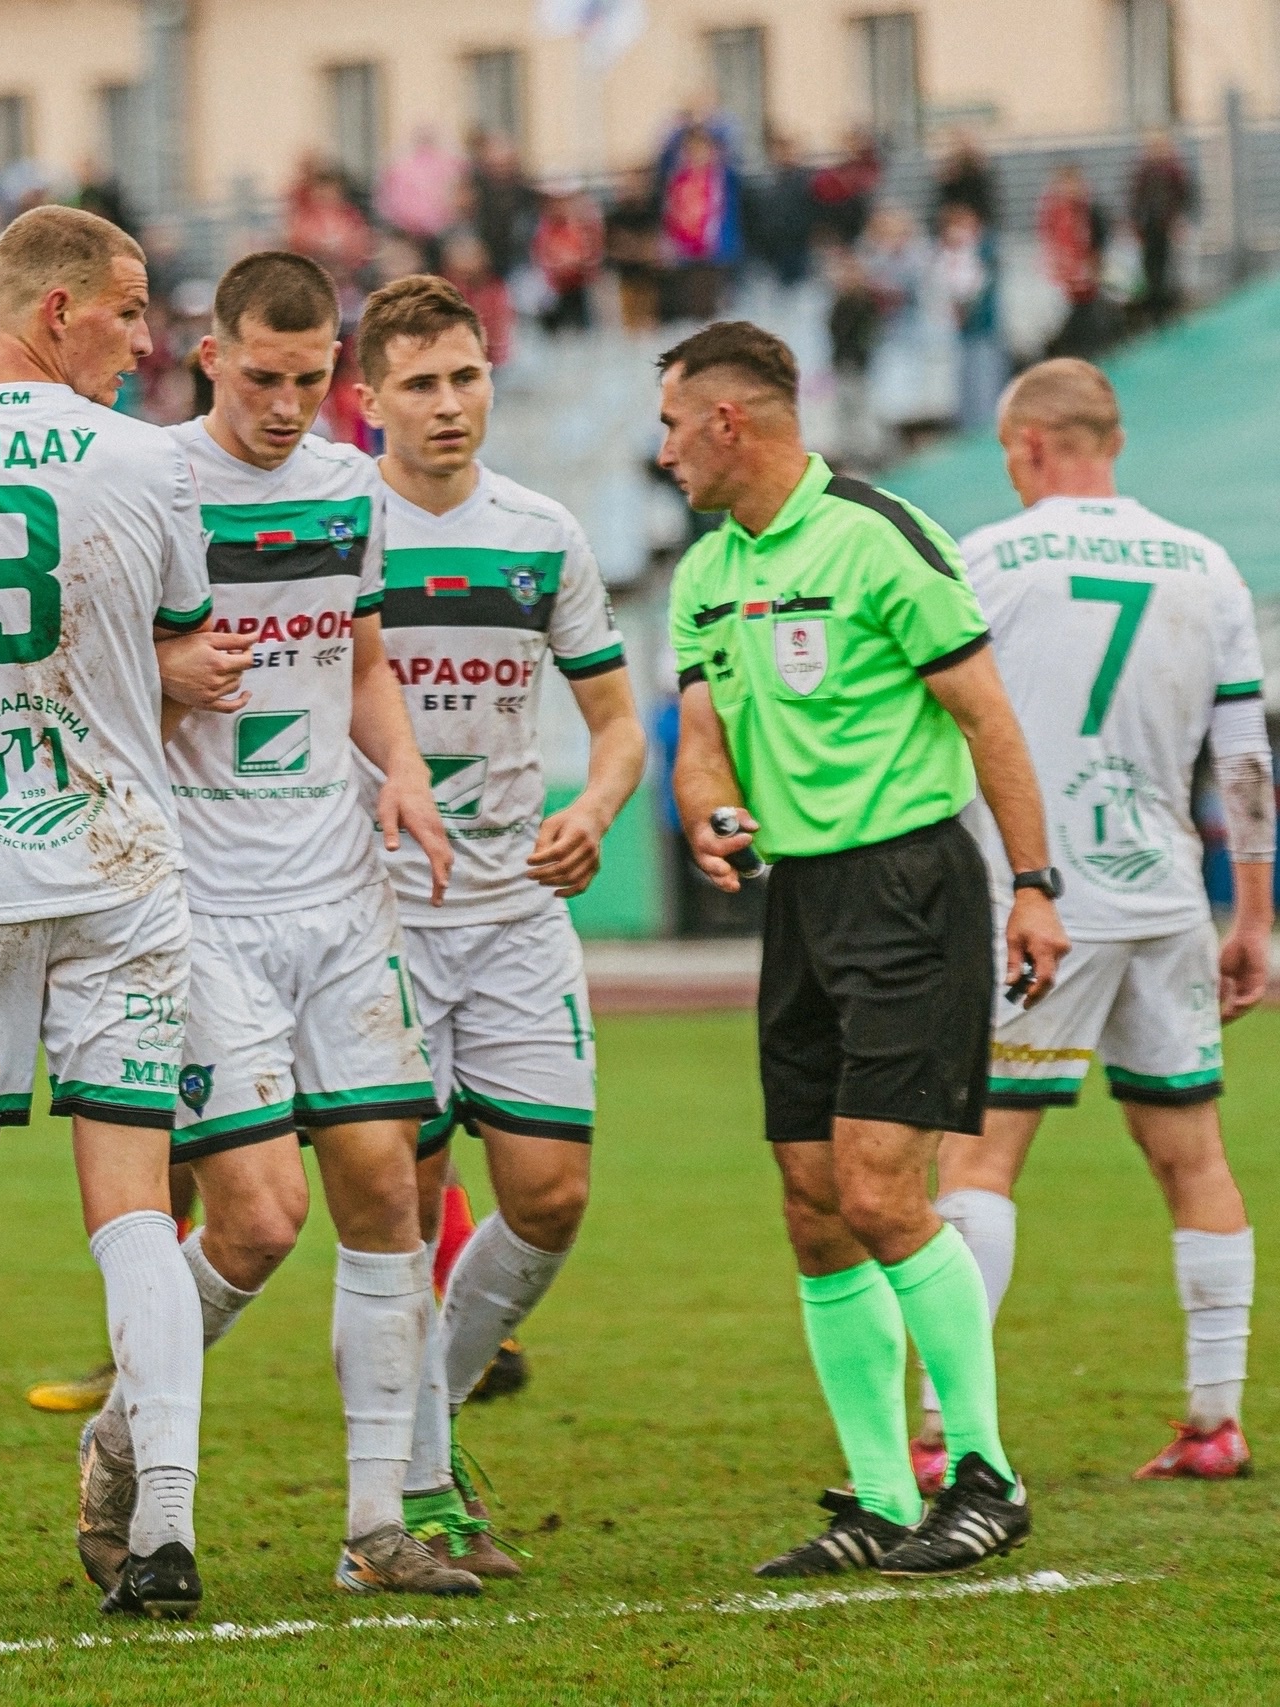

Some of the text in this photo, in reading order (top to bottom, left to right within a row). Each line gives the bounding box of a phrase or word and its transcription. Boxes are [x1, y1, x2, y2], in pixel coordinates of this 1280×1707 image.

[213, 611, 353, 643] АРАФОН
[1070, 575, 1155, 737] 7
[388, 658, 538, 687] АРАФОН
[423, 694, 477, 711] БЕТ
[21, 788, 47, 799] 1939
